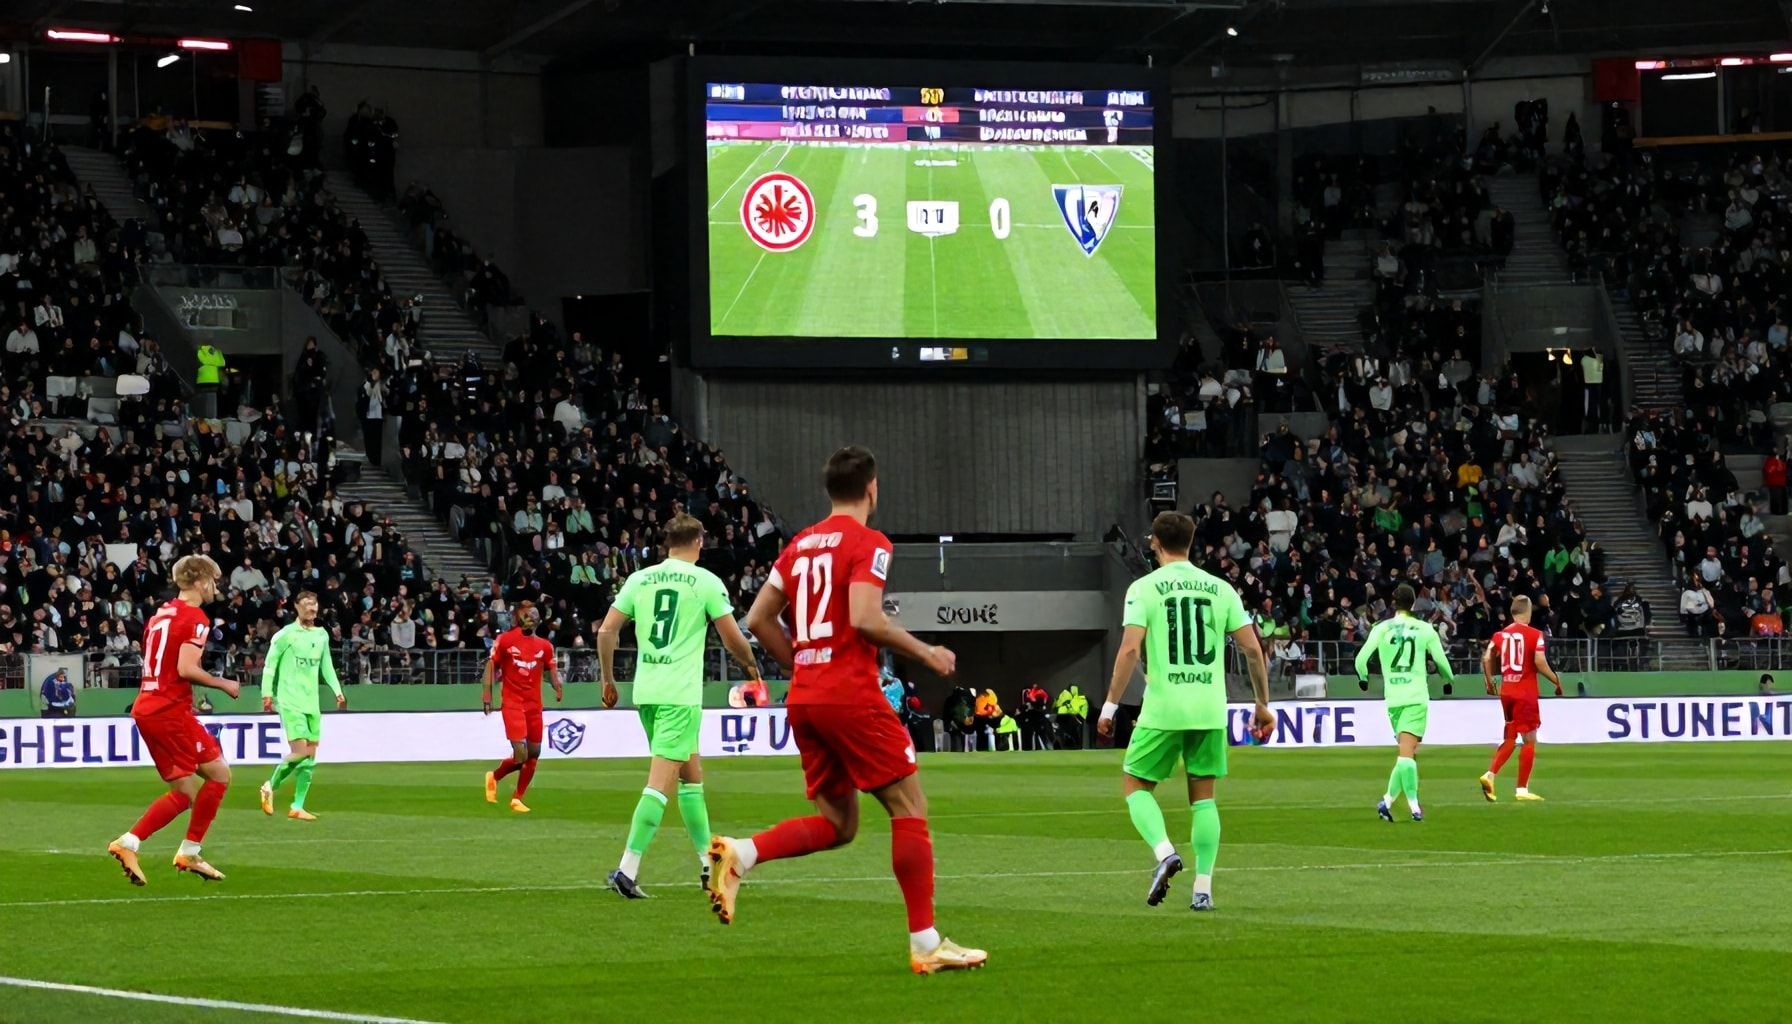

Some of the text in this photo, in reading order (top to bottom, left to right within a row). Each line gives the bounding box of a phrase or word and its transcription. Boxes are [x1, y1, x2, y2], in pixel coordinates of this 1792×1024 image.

[853, 193, 878, 238] 3
[989, 197, 1011, 240] 0
[791, 552, 833, 643] 12
[0, 724, 141, 764] HELLI
